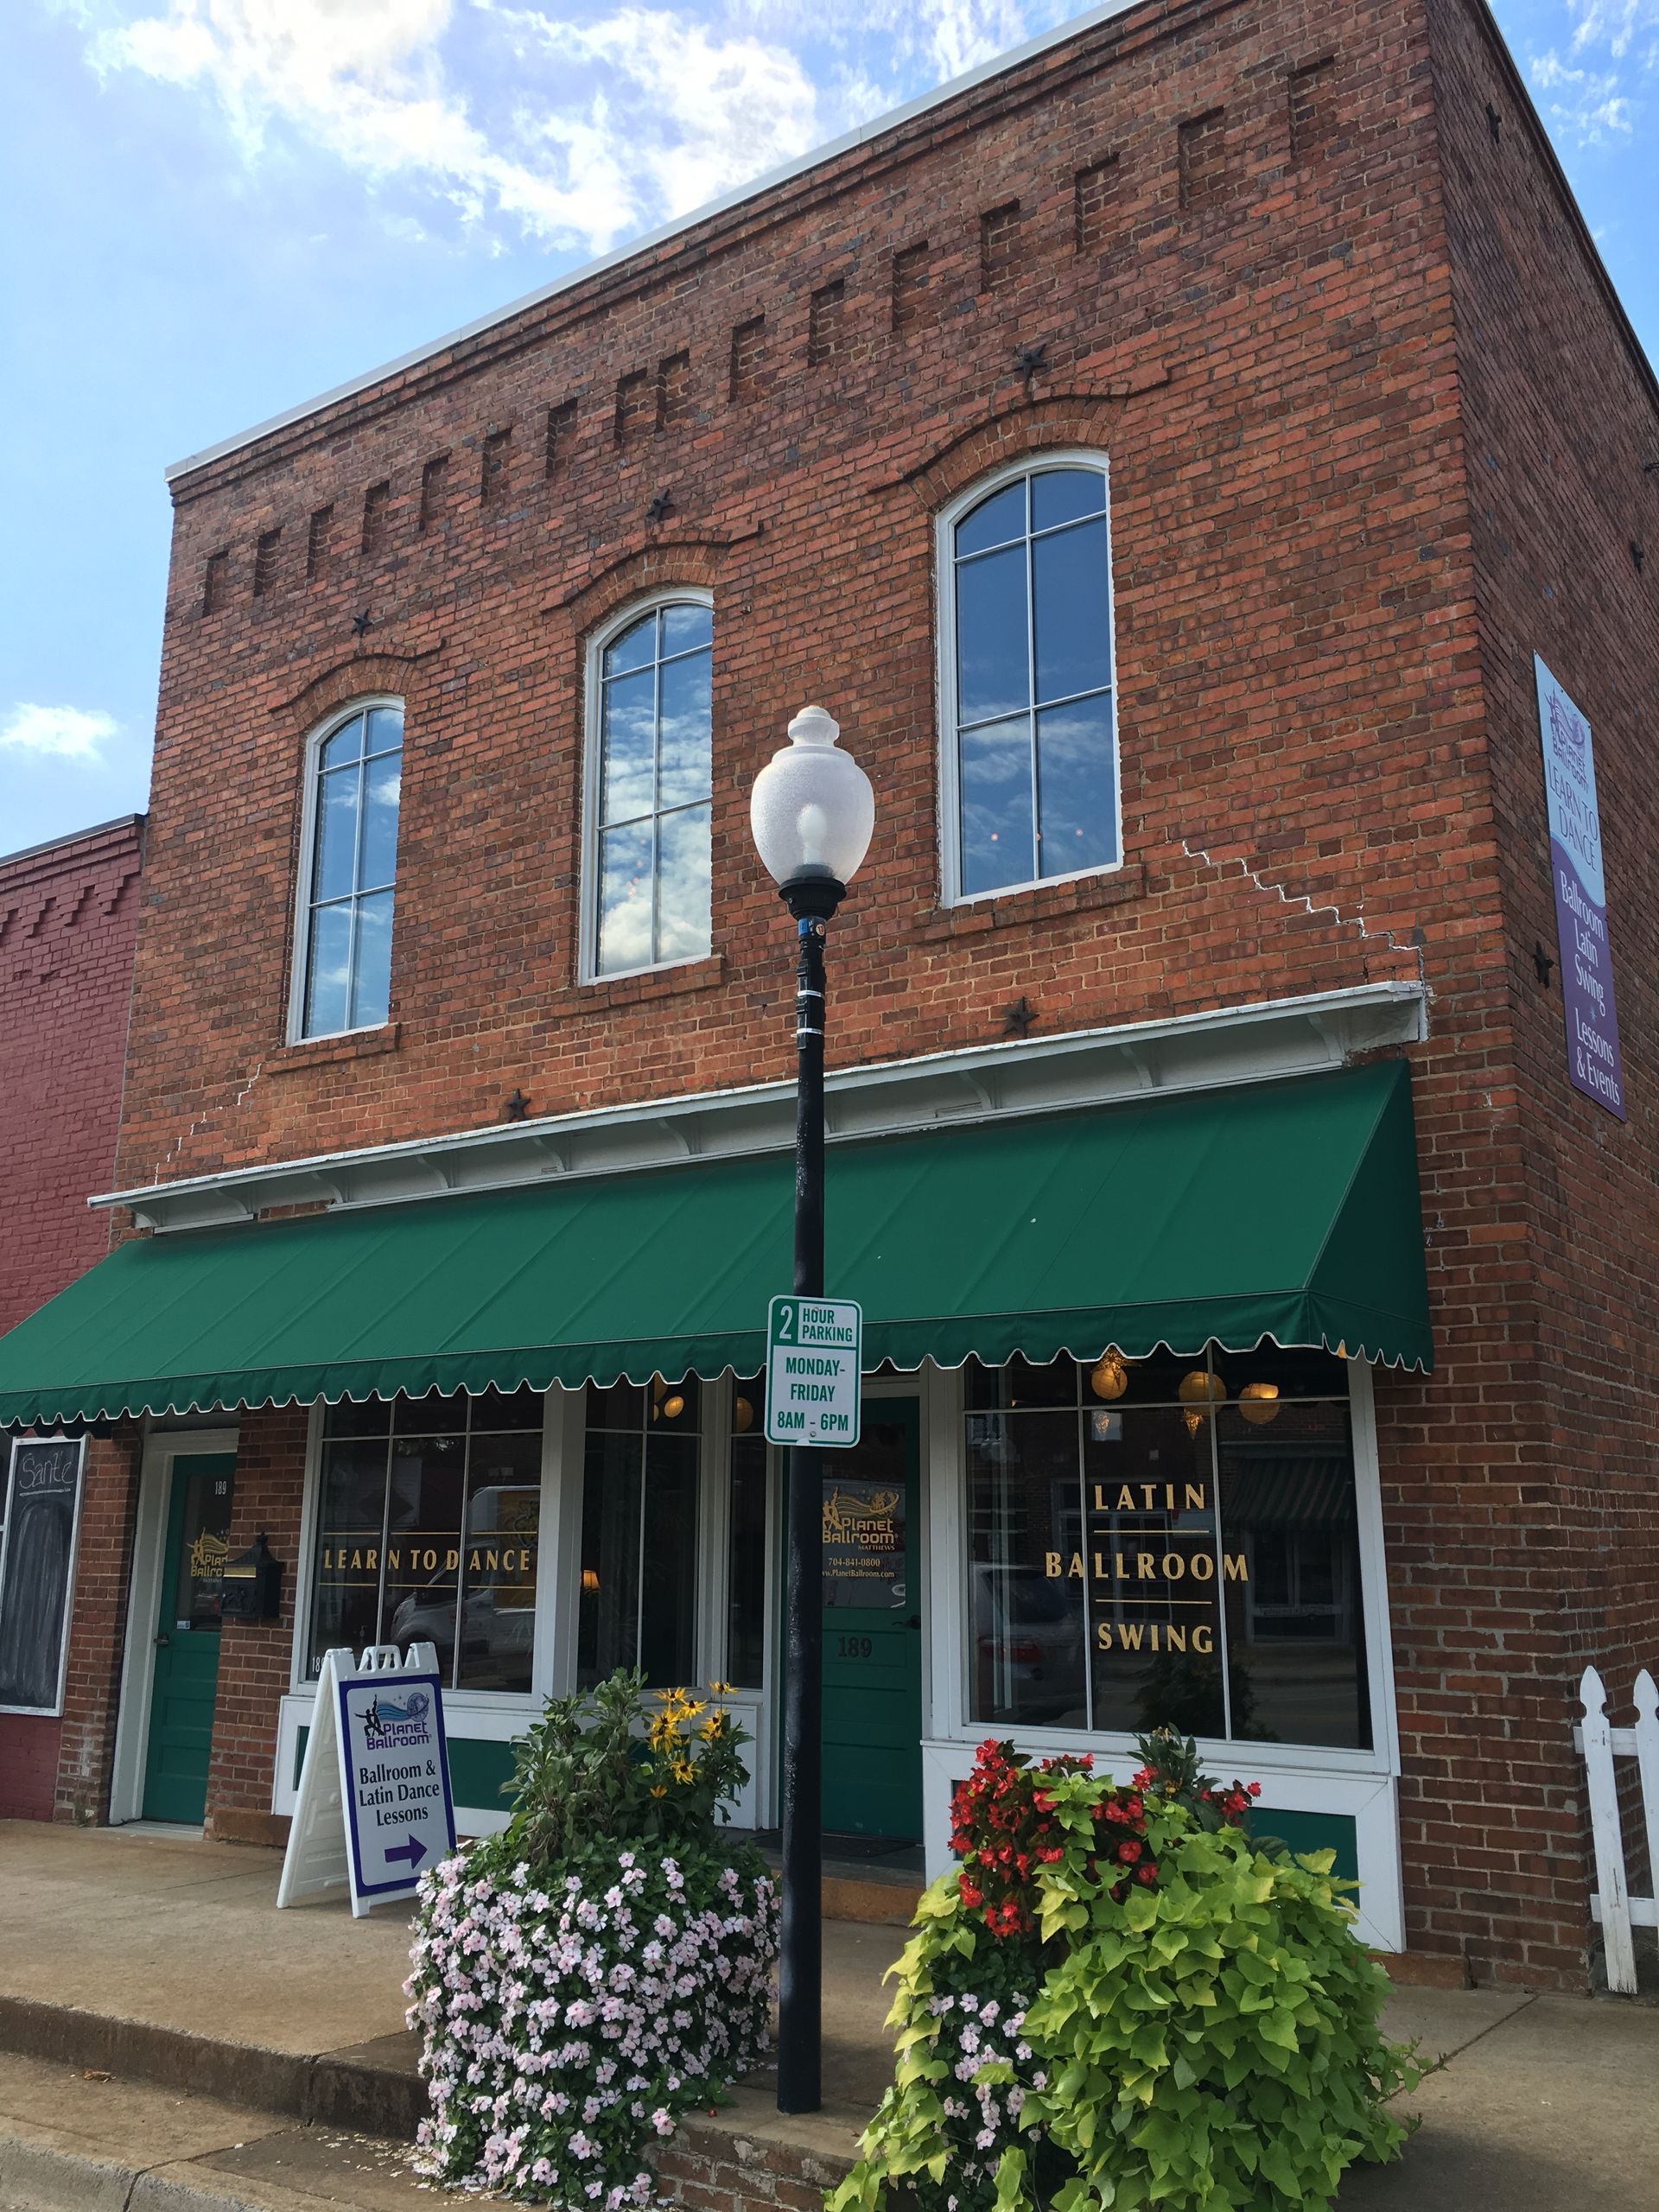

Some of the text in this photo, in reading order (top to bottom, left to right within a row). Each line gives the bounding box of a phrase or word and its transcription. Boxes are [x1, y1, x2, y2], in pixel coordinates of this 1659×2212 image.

[1548, 759, 1599, 842] LEARN TO
[1559, 805, 1597, 872] DANCE
[1560, 870, 1605, 942] Ballroom
[1573, 918, 1599, 969] Latin
[1574, 954, 1606, 1017] Swing
[1574, 1007, 1614, 1068] Lessons
[1576, 1045, 1620, 1107] & Events
[779, 1305, 793, 1339] 2
[803, 1307, 835, 1325] HOUR
[802, 1325, 853, 1342] PARKING
[791, 1383, 836, 1402] FRIDAY
[777, 1411, 804, 1429] 8AM
[820, 1413, 849, 1431] 6PM
[215, 1480, 226, 1496] 189
[1094, 1483, 1205, 1510] LATIN
[842, 1517, 893, 1533] Planet
[823, 1530, 894, 1544] Ballroom
[324, 1549, 531, 1571] LEARN TO DANCE
[828, 1557, 880, 1567] 704-841-0800
[1045, 1551, 1249, 1581] BALLROOM
[191, 1566, 223, 1577] Ballro
[837, 1637, 872, 1658] 189
[1097, 1623, 1213, 1653] SWING
[383, 1719, 429, 1735] Planet
[366, 1733, 429, 1751] Ballroom
[359, 1758, 436, 1785] Ballroom &
[359, 1783, 441, 1807] Latin Dance
[376, 1806, 429, 1827] Lessons
